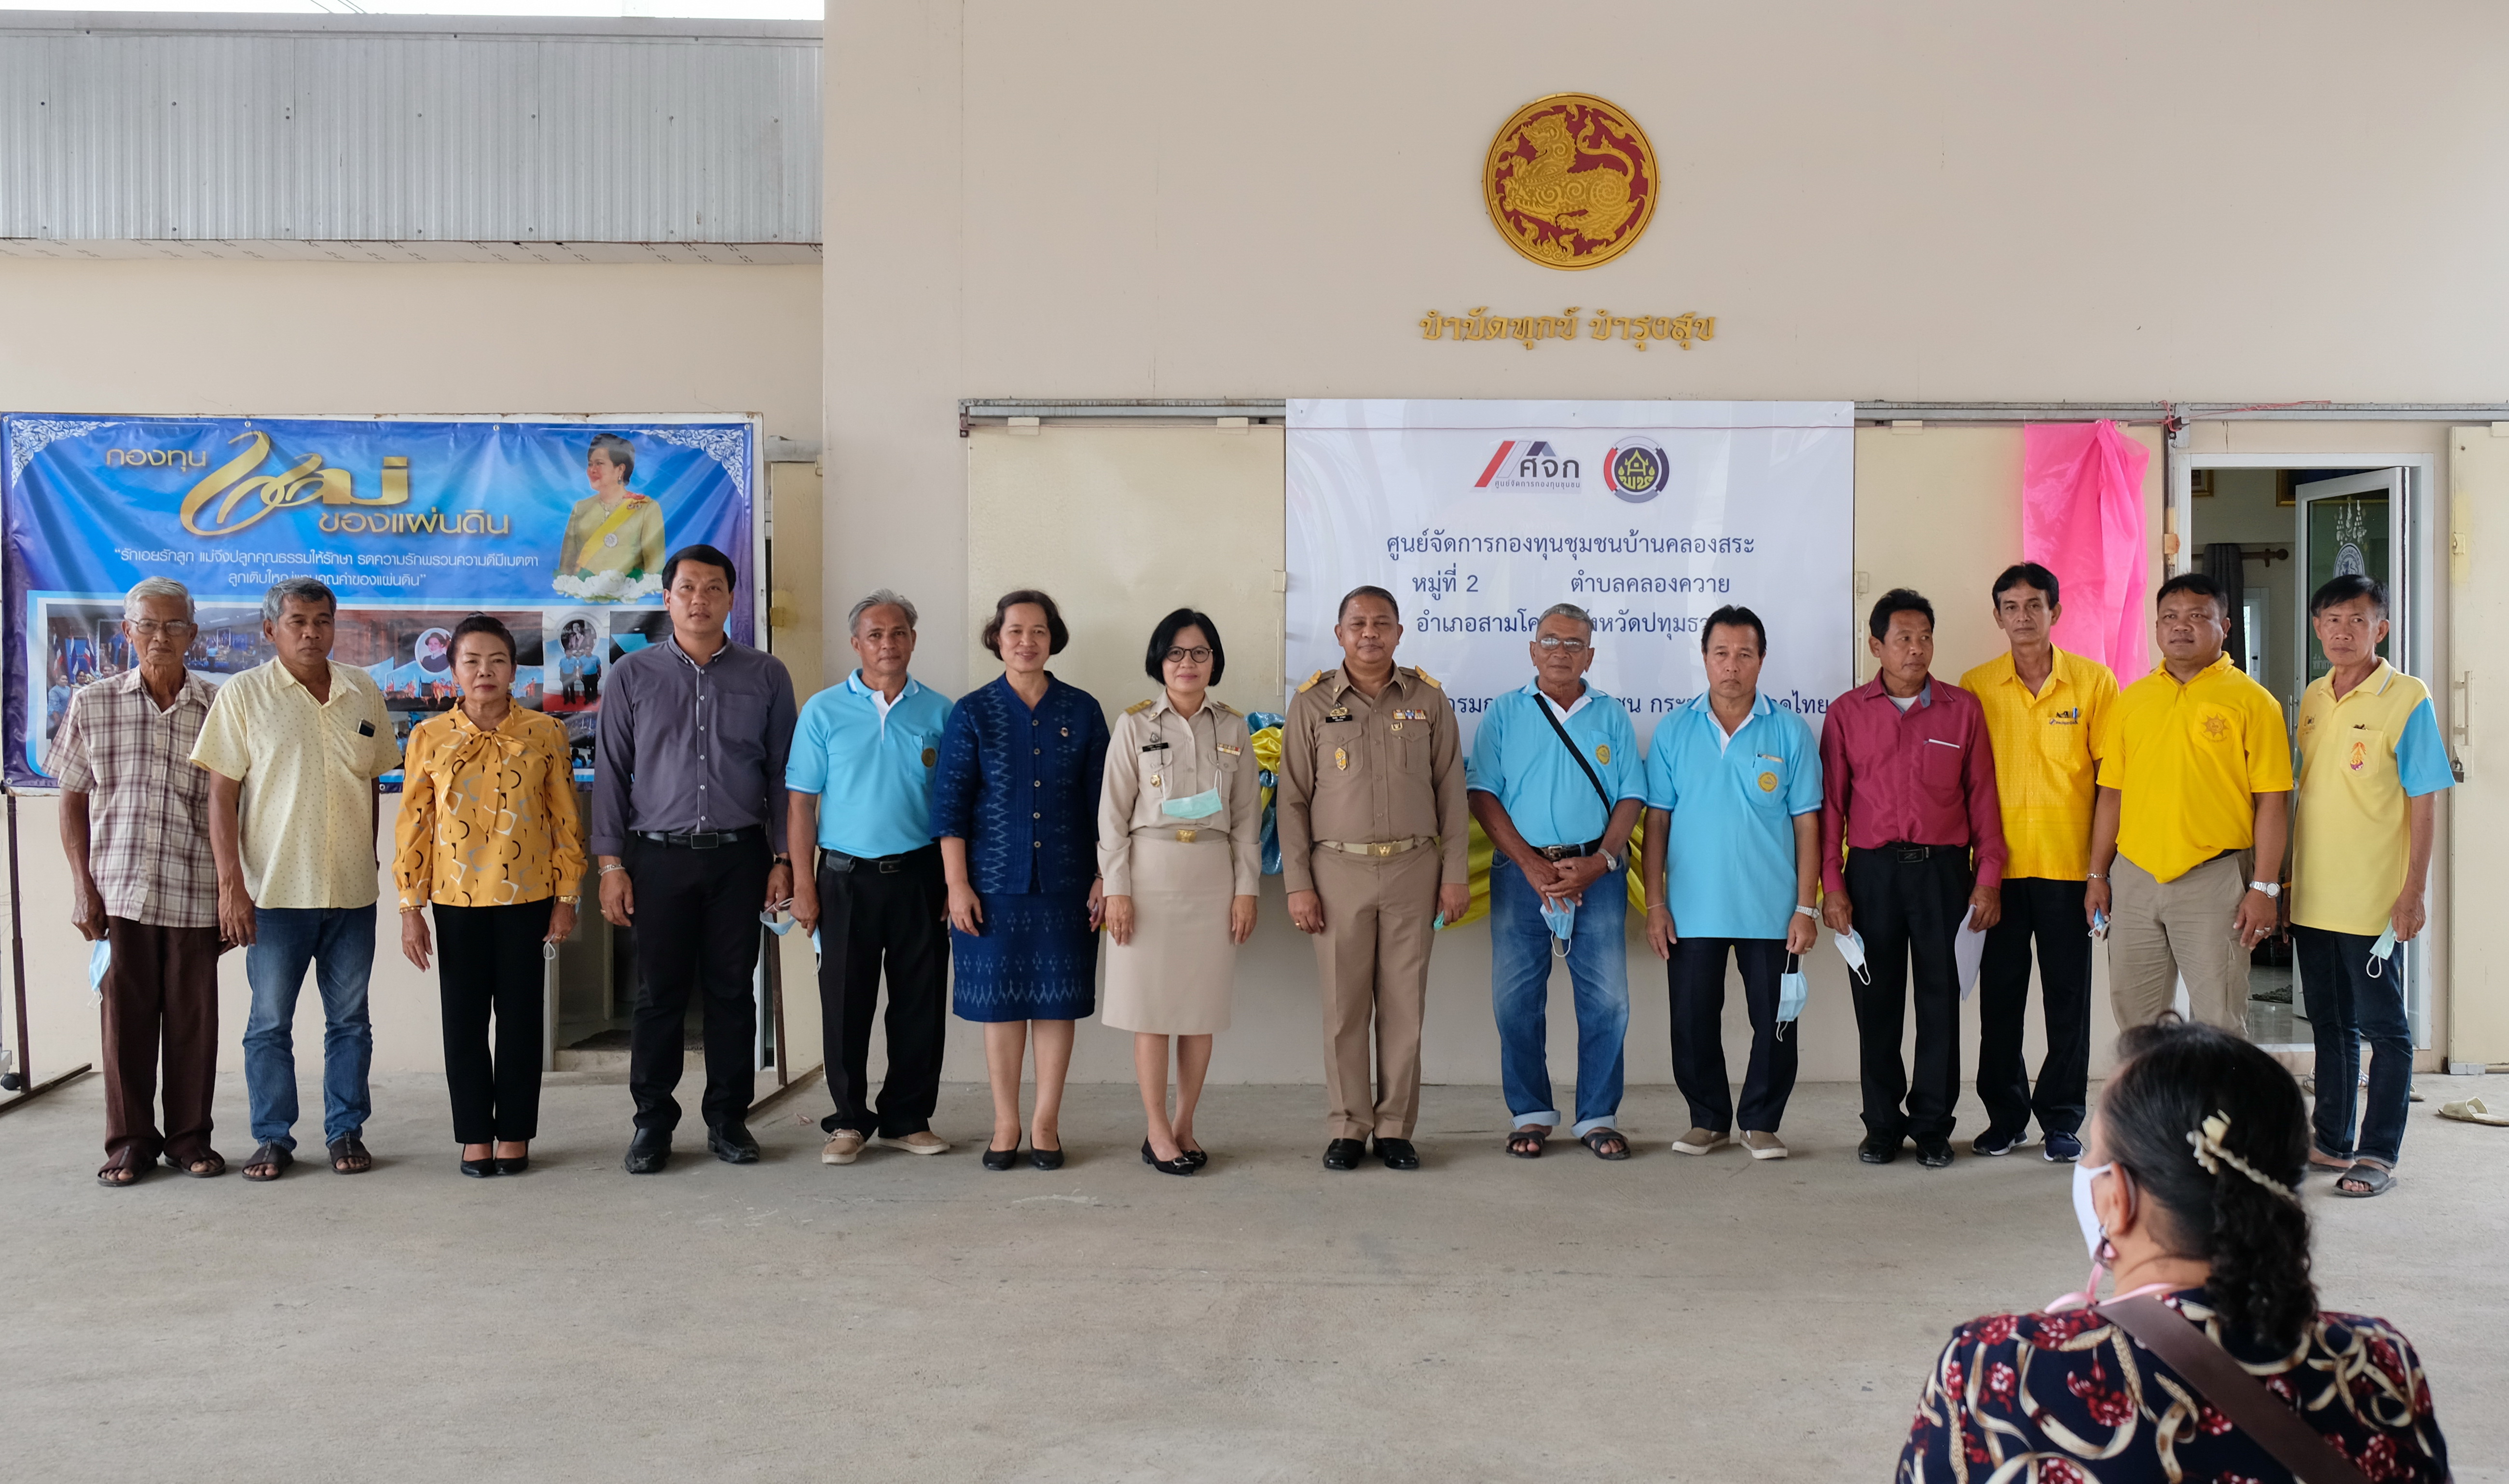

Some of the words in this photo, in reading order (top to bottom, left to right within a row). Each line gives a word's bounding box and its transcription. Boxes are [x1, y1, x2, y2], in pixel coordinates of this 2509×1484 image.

[1419, 306, 1580, 350] บำบัดทุกข์
[1589, 308, 1716, 351] บำรุงสุข
[105, 447, 207, 471] กองทุน
[1520, 457, 1579, 479] ศจก
[1495, 479, 1580, 490] ศูนย์จัดการกองทุนชุมชน
[318, 506, 510, 535] ของแผ่นดิน
[1387, 528, 1754, 561] ศูนย์จัดการกองทุนชุมชนบ้านคลองสระ
[1412, 563, 1457, 601] หมู่ที่
[1466, 574, 1479, 592] 2
[1571, 569, 1730, 593] ตำบลคลองควาย
[1416, 608, 1539, 632] อำเภอสามโค
